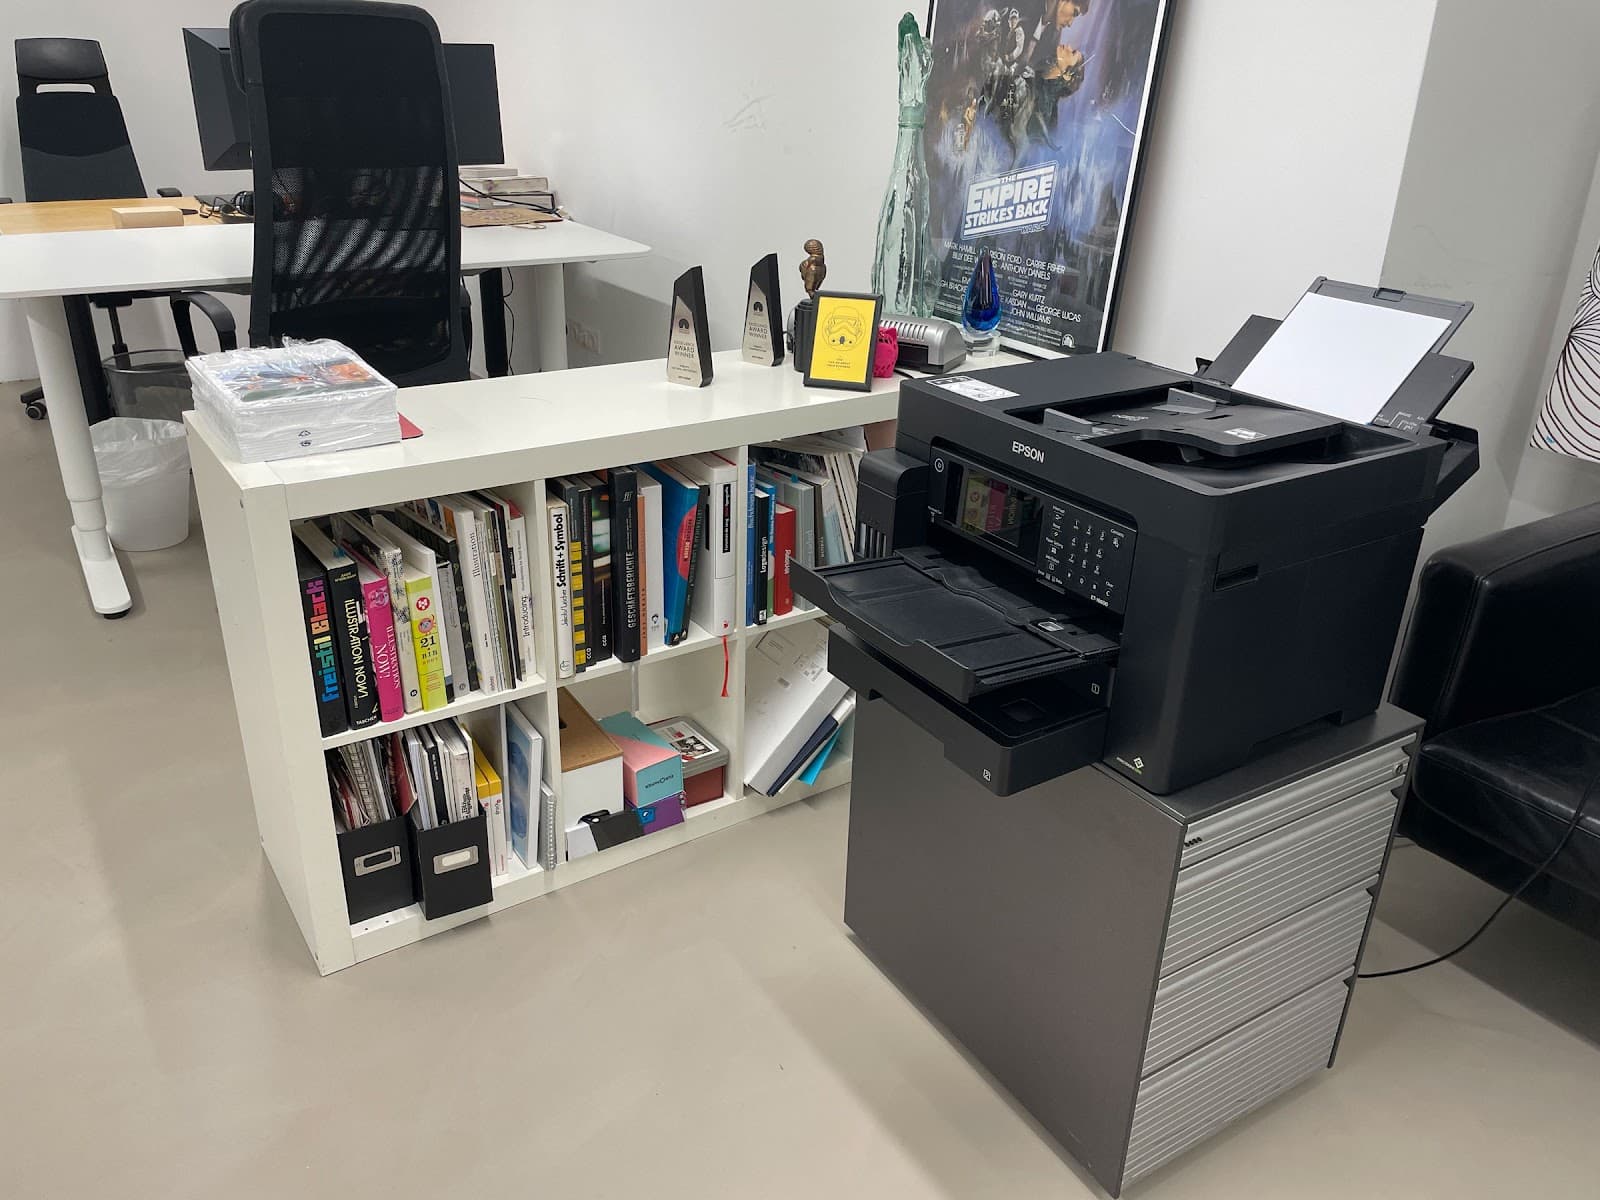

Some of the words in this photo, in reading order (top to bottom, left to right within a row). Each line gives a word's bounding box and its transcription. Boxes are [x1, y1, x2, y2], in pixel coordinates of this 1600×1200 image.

[1001, 174, 1017, 184] THE
[967, 173, 1054, 213] EMPIRE
[965, 207, 1014, 228] STRIKES
[1016, 200, 1049, 220] BACK
[964, 254, 973, 263] DEE
[1001, 263, 1028, 276] ANTHONY
[1028, 268, 1051, 281] DANIELS
[1007, 254, 1022, 264] FORD
[1026, 258, 1047, 271] CARRIE
[1047, 262, 1066, 275] FISHER
[1012, 289, 1028, 299] GARY
[1029, 292, 1046, 304] KURTZ
[1010, 307, 1026, 318] JOHN
[1026, 311, 1051, 325] WILLIAMS
[1036, 304, 1061, 318] GEORGE
[1061, 310, 1081, 323] LUCAS
[749, 326, 768, 334] AWARD
[674, 345, 695, 353] AWARD
[674, 351, 694, 359] WINNER
[1012, 441, 1045, 463] EPSON
[552, 513, 565, 551] Symbol
[471, 532, 482, 578] Illustration
[555, 551, 563, 559] +
[556, 558, 567, 587] Schrift
[625, 552, 637, 629] GESCHÄFTSBERICHTE
[344, 599, 363, 665] ILLUSTRATION
[354, 665, 369, 699] NOW!
[420, 636, 436, 649] 21
[375, 643, 390, 680] NOW!
[386, 625, 401, 690] ILLUSTRATION
